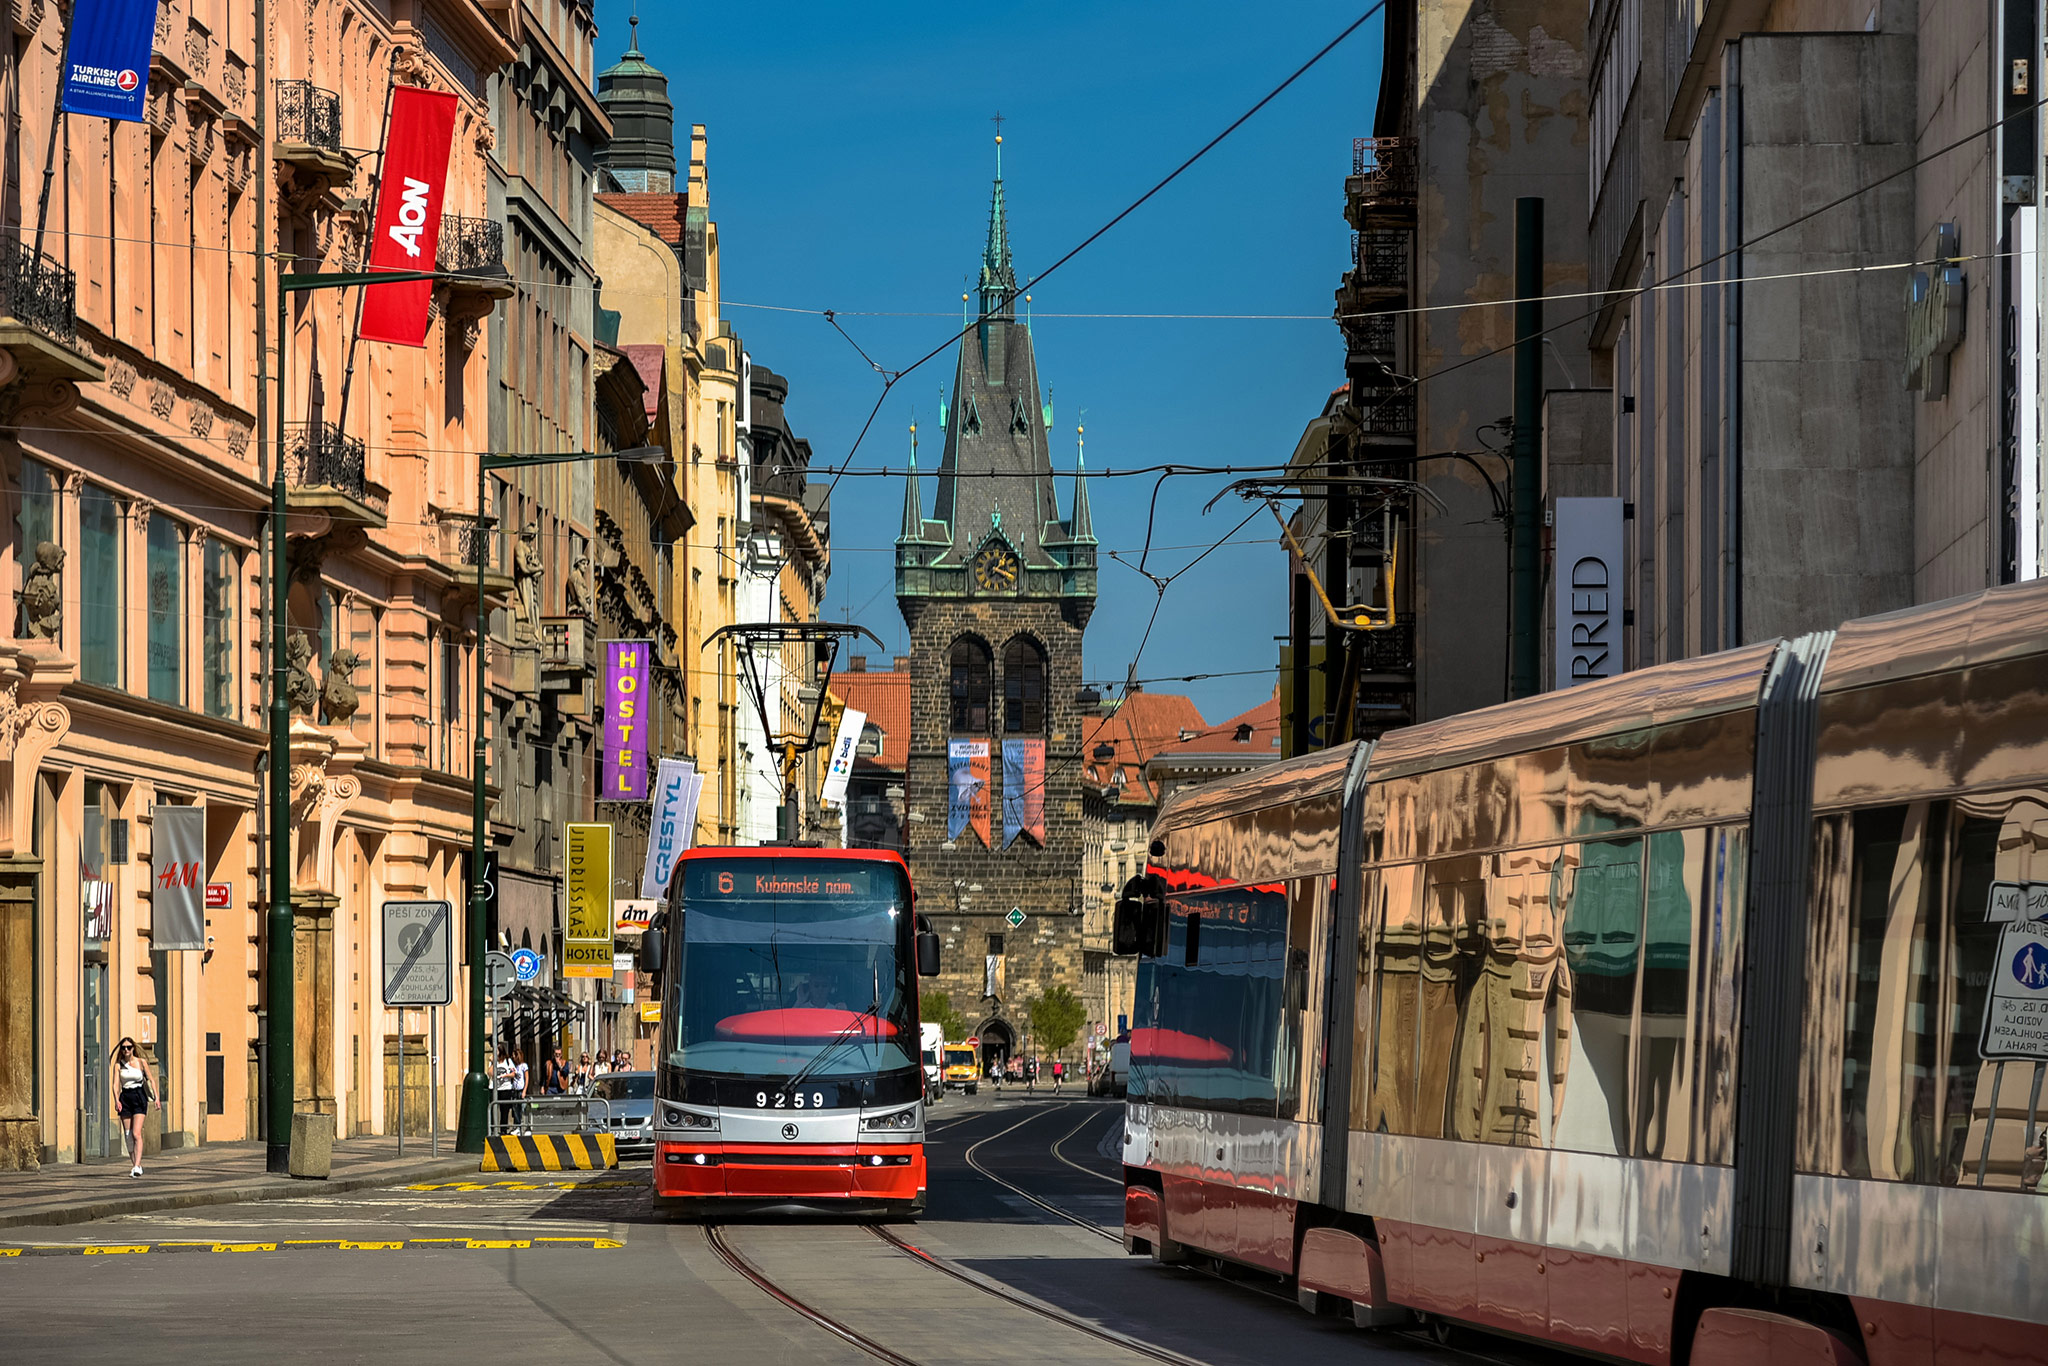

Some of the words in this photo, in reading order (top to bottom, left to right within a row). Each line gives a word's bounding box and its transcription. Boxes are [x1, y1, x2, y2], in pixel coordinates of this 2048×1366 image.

[70, 73, 117, 87] AIRLINES
[72, 64, 118, 79] TURKISH
[617, 651, 637, 792] HOSTEL
[840, 736, 852, 758] bidli
[655, 776, 682, 885] CRESTYL
[157, 862, 200, 890] H&M
[570, 828, 586, 927] JINDŘIŠSKÁ
[718, 871, 735, 894] 6
[755, 875, 819, 894] Kubánské
[825, 878, 855, 894] nám.
[389, 906, 411, 918] PĚŠÍ
[415, 906, 436, 918] ZÓN
[622, 904, 649, 921] dm
[569, 928, 608, 938] PASÁŽ
[566, 948, 611, 961] HOSTEL
[756, 1092, 823, 1109] 9259
